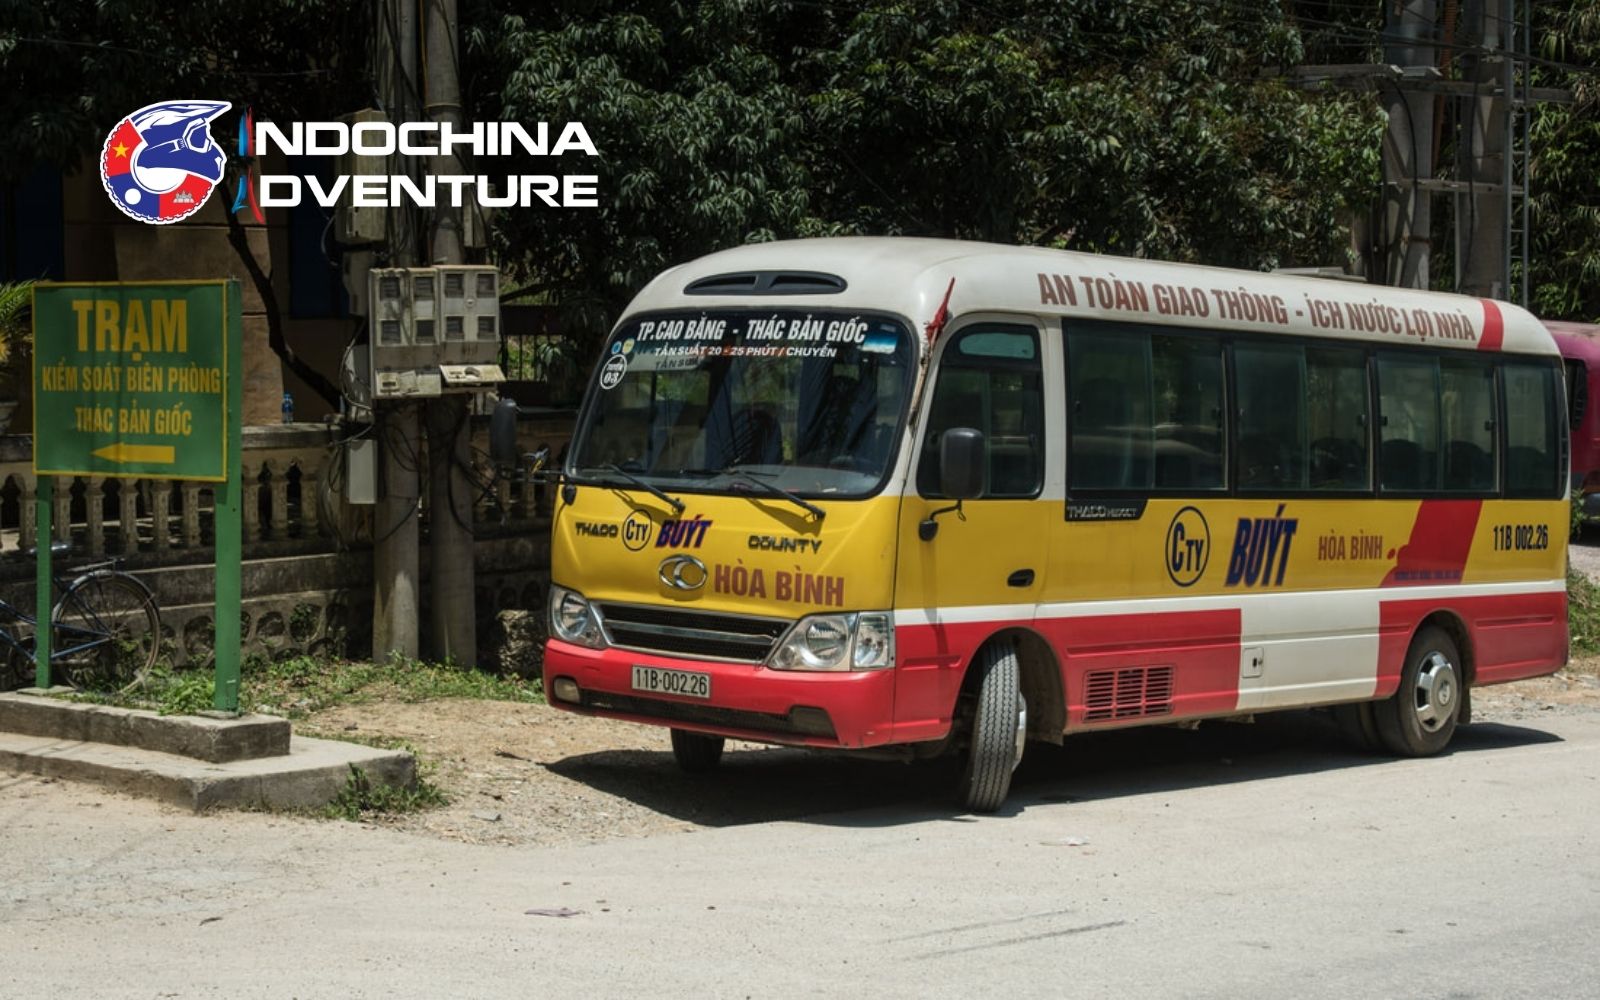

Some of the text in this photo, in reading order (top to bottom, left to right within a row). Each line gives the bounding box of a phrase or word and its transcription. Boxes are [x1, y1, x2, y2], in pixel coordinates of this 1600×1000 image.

[1037, 273, 1077, 306] AN
[1079, 272, 1149, 312] TOÀN
[1152, 284, 1209, 317] GIAO
[1210, 286, 1289, 325] THÔNG
[1432, 309, 1476, 341] NHÀ
[72, 299, 187, 362] TRẠM
[745, 314, 787, 340] THÁC
[787, 314, 825, 340] BẢN
[825, 316, 868, 343] GIỐC
[707, 347, 722, 356] 20
[730, 347, 745, 356] 25
[745, 343, 778, 356] PHÚT
[82, 361, 122, 392] SOÁT
[127, 361, 163, 392] BIÊN
[168, 361, 221, 393] PHÒNG
[75, 399, 192, 437] THÁC BẢN GIỐC
[655, 514, 713, 548] BUÝT
[748, 535, 822, 554] COUNTY
[1225, 504, 1298, 587] BUÝT
[1318, 530, 1382, 560] HÒA BÌNH
[1494, 525, 1548, 550] 11B 002.26
[714, 559, 845, 607] HÒA BÌNH
